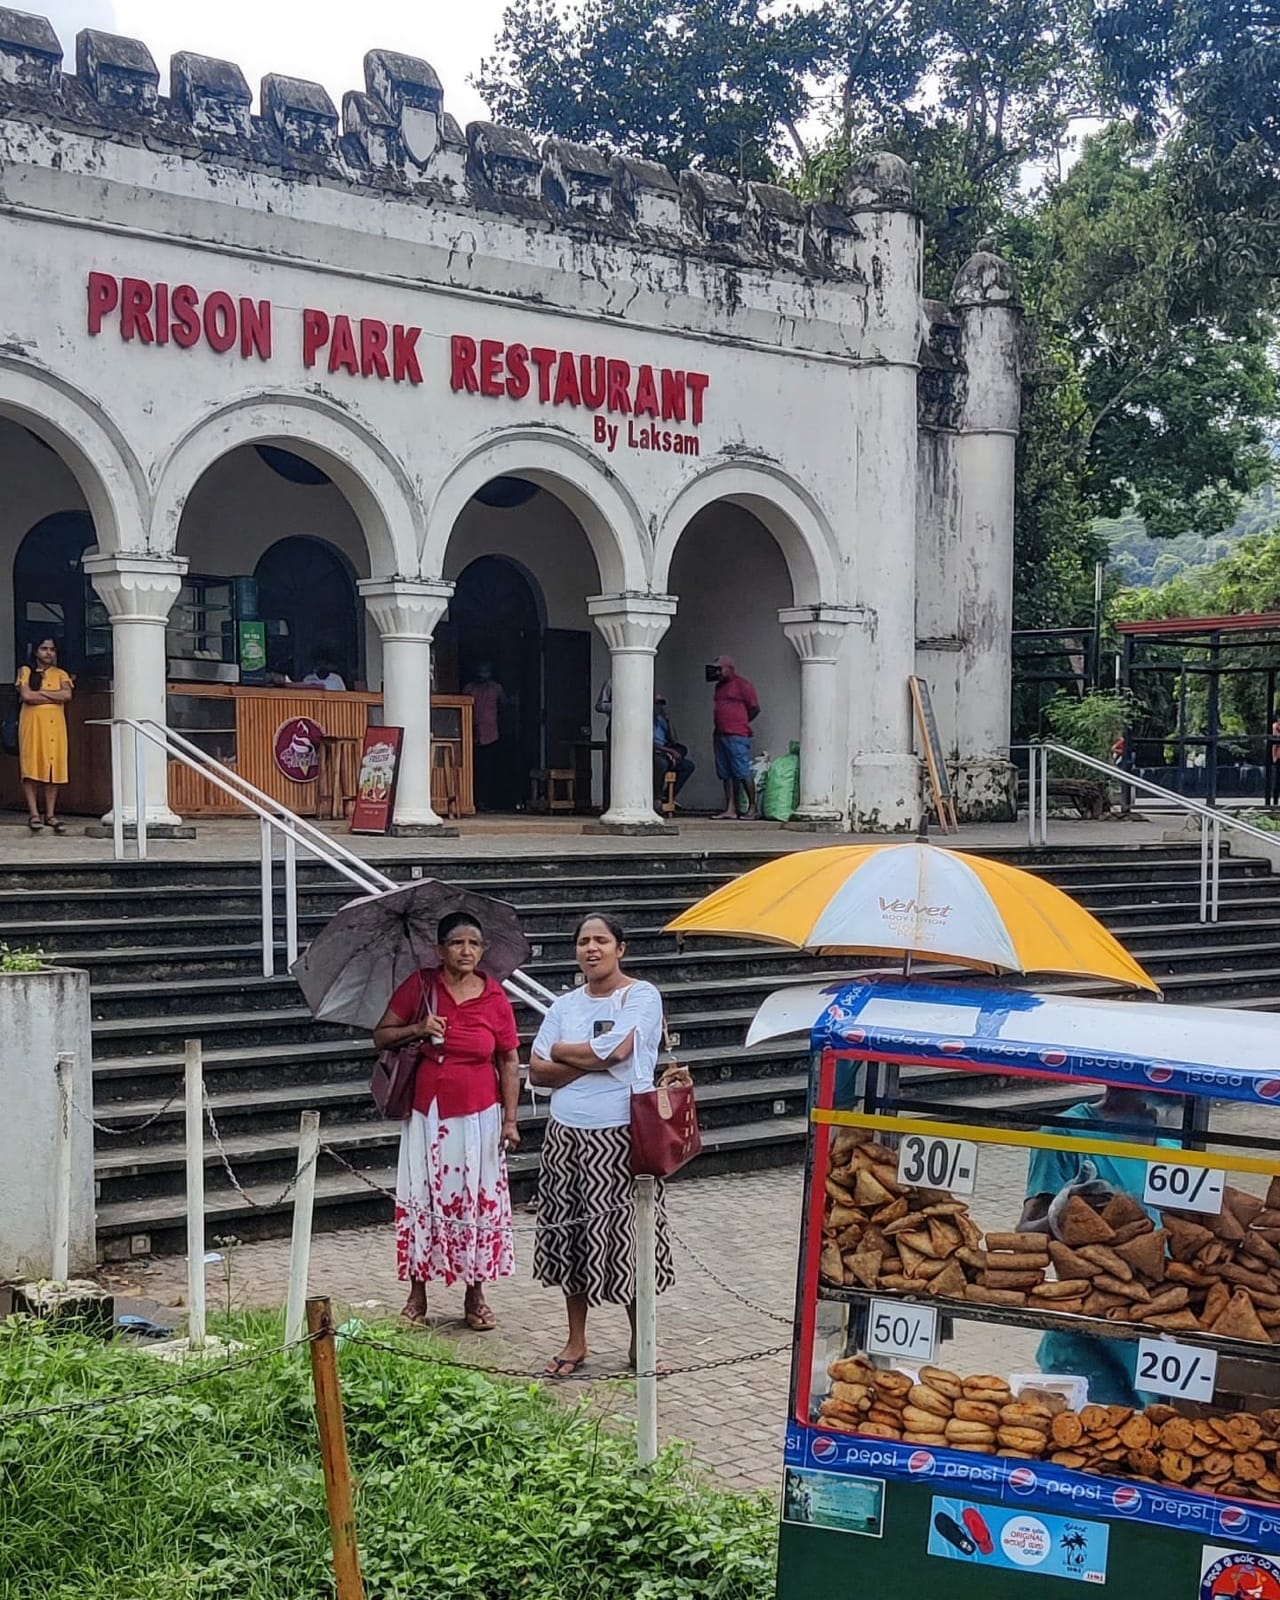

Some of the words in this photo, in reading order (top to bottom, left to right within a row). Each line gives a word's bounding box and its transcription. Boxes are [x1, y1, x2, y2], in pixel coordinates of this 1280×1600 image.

[87, 272, 271, 360] PRISON
[303, 308, 423, 385] PARK
[450, 335, 709, 427] RESTAURANT
[594, 415, 618, 452] By
[628, 420, 699, 456] Laksam
[879, 897, 952, 917] Velvet
[911, 915, 946, 926] LTION
[1186, 1070, 1242, 1087] pepsi
[904, 1137, 970, 1188] 30/-
[1149, 1165, 1220, 1202] 60/-
[874, 1315, 929, 1348] 50/-
[1139, 1352, 1212, 1391] 20/-
[847, 1448, 898, 1467] pepsi
[944, 1463, 998, 1482] pepsi
[1046, 1479, 1100, 1500] pepsi
[1151, 1498, 1208, 1519] pepsi
